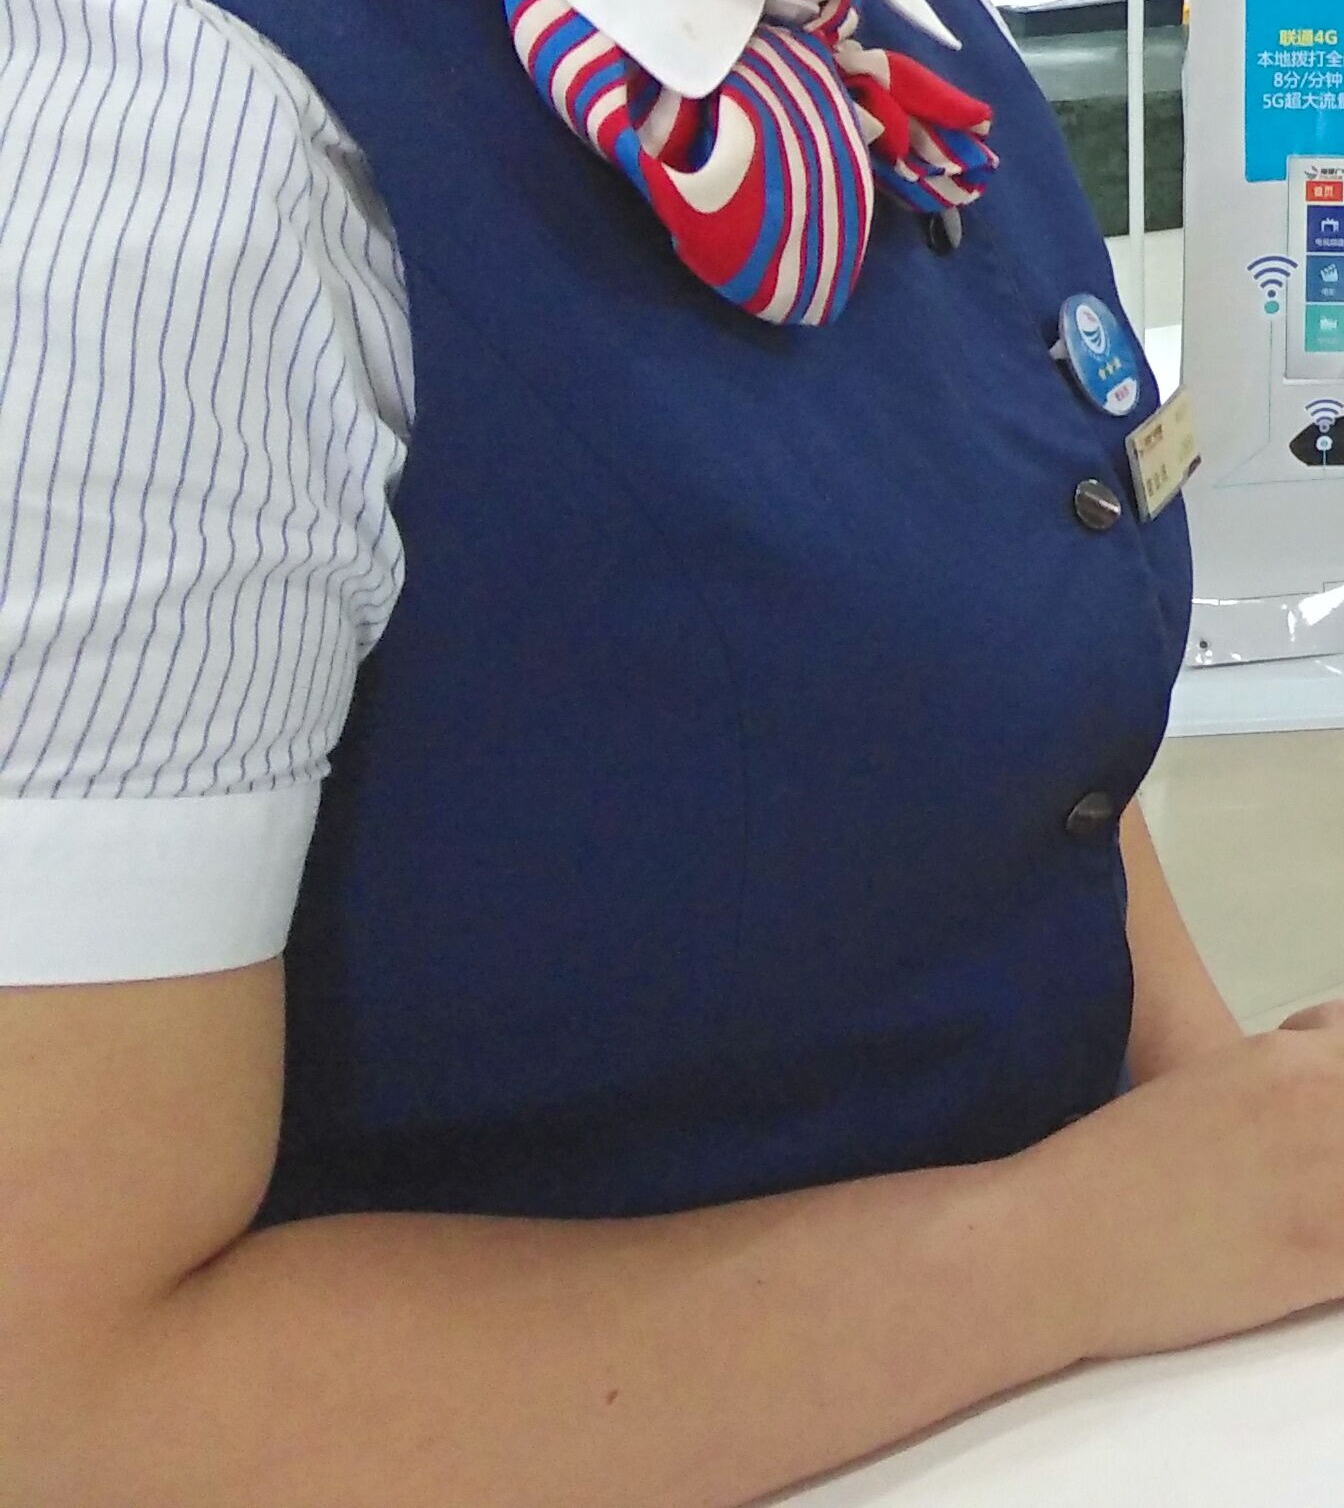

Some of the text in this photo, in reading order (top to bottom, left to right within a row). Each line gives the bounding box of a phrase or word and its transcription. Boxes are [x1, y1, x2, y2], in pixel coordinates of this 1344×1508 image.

[1279, 29, 1338, 47] 联通4G
[1273, 71, 1343, 90] 8分/分钟
